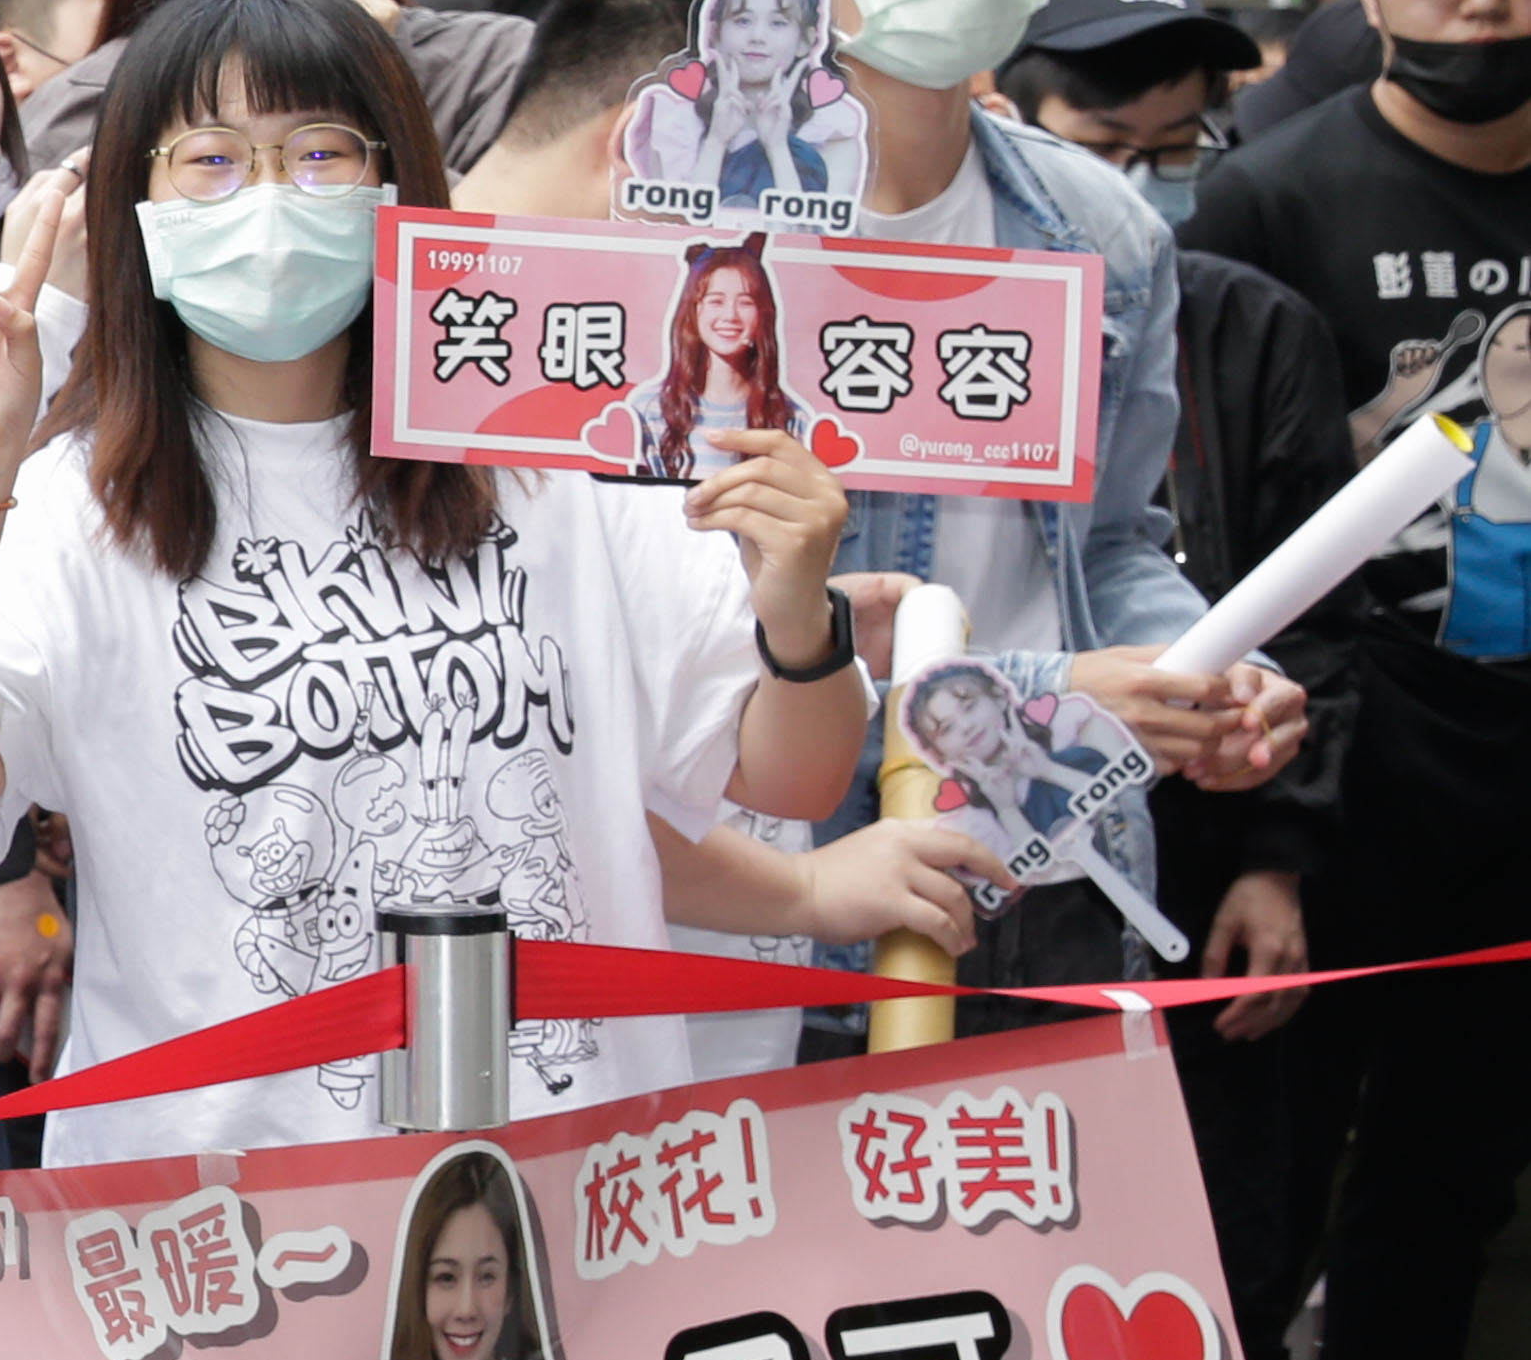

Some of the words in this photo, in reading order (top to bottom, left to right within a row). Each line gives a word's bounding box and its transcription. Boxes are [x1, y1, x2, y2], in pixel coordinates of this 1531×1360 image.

[625, 180, 715, 219] rong
[764, 190, 854, 232] rong
[426, 250, 524, 277] 19991107
[432, 291, 628, 391] 笑眼
[820, 318, 1032, 420] 容容
[173, 624, 575, 794] BOTTOM
[1070, 746, 1151, 817] rong
[582, 1116, 763, 1263] 校花!
[848, 1099, 1065, 1208] 好美!
